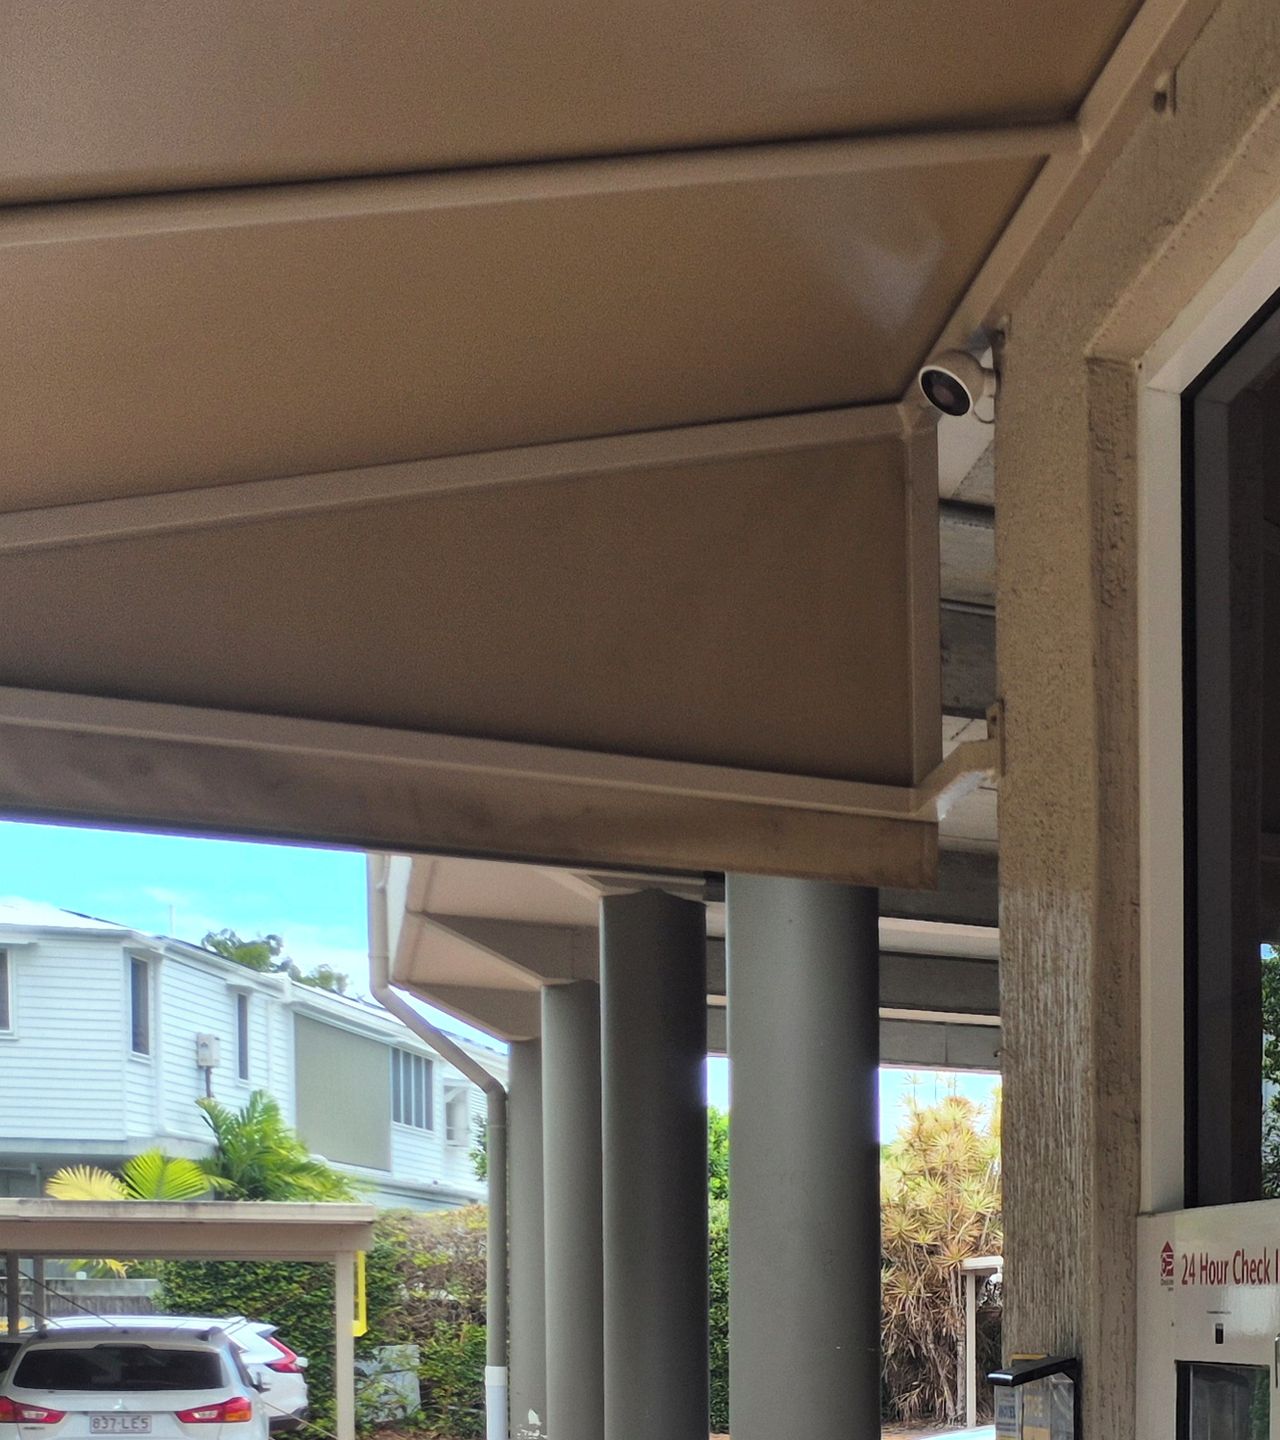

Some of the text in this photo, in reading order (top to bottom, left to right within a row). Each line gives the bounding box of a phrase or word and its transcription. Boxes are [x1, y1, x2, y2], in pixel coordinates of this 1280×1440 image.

[1181, 1252, 1196, 1285] 24
[1200, 1252, 1229, 1285] Hour
[1232, 1246, 1271, 1285] Check
